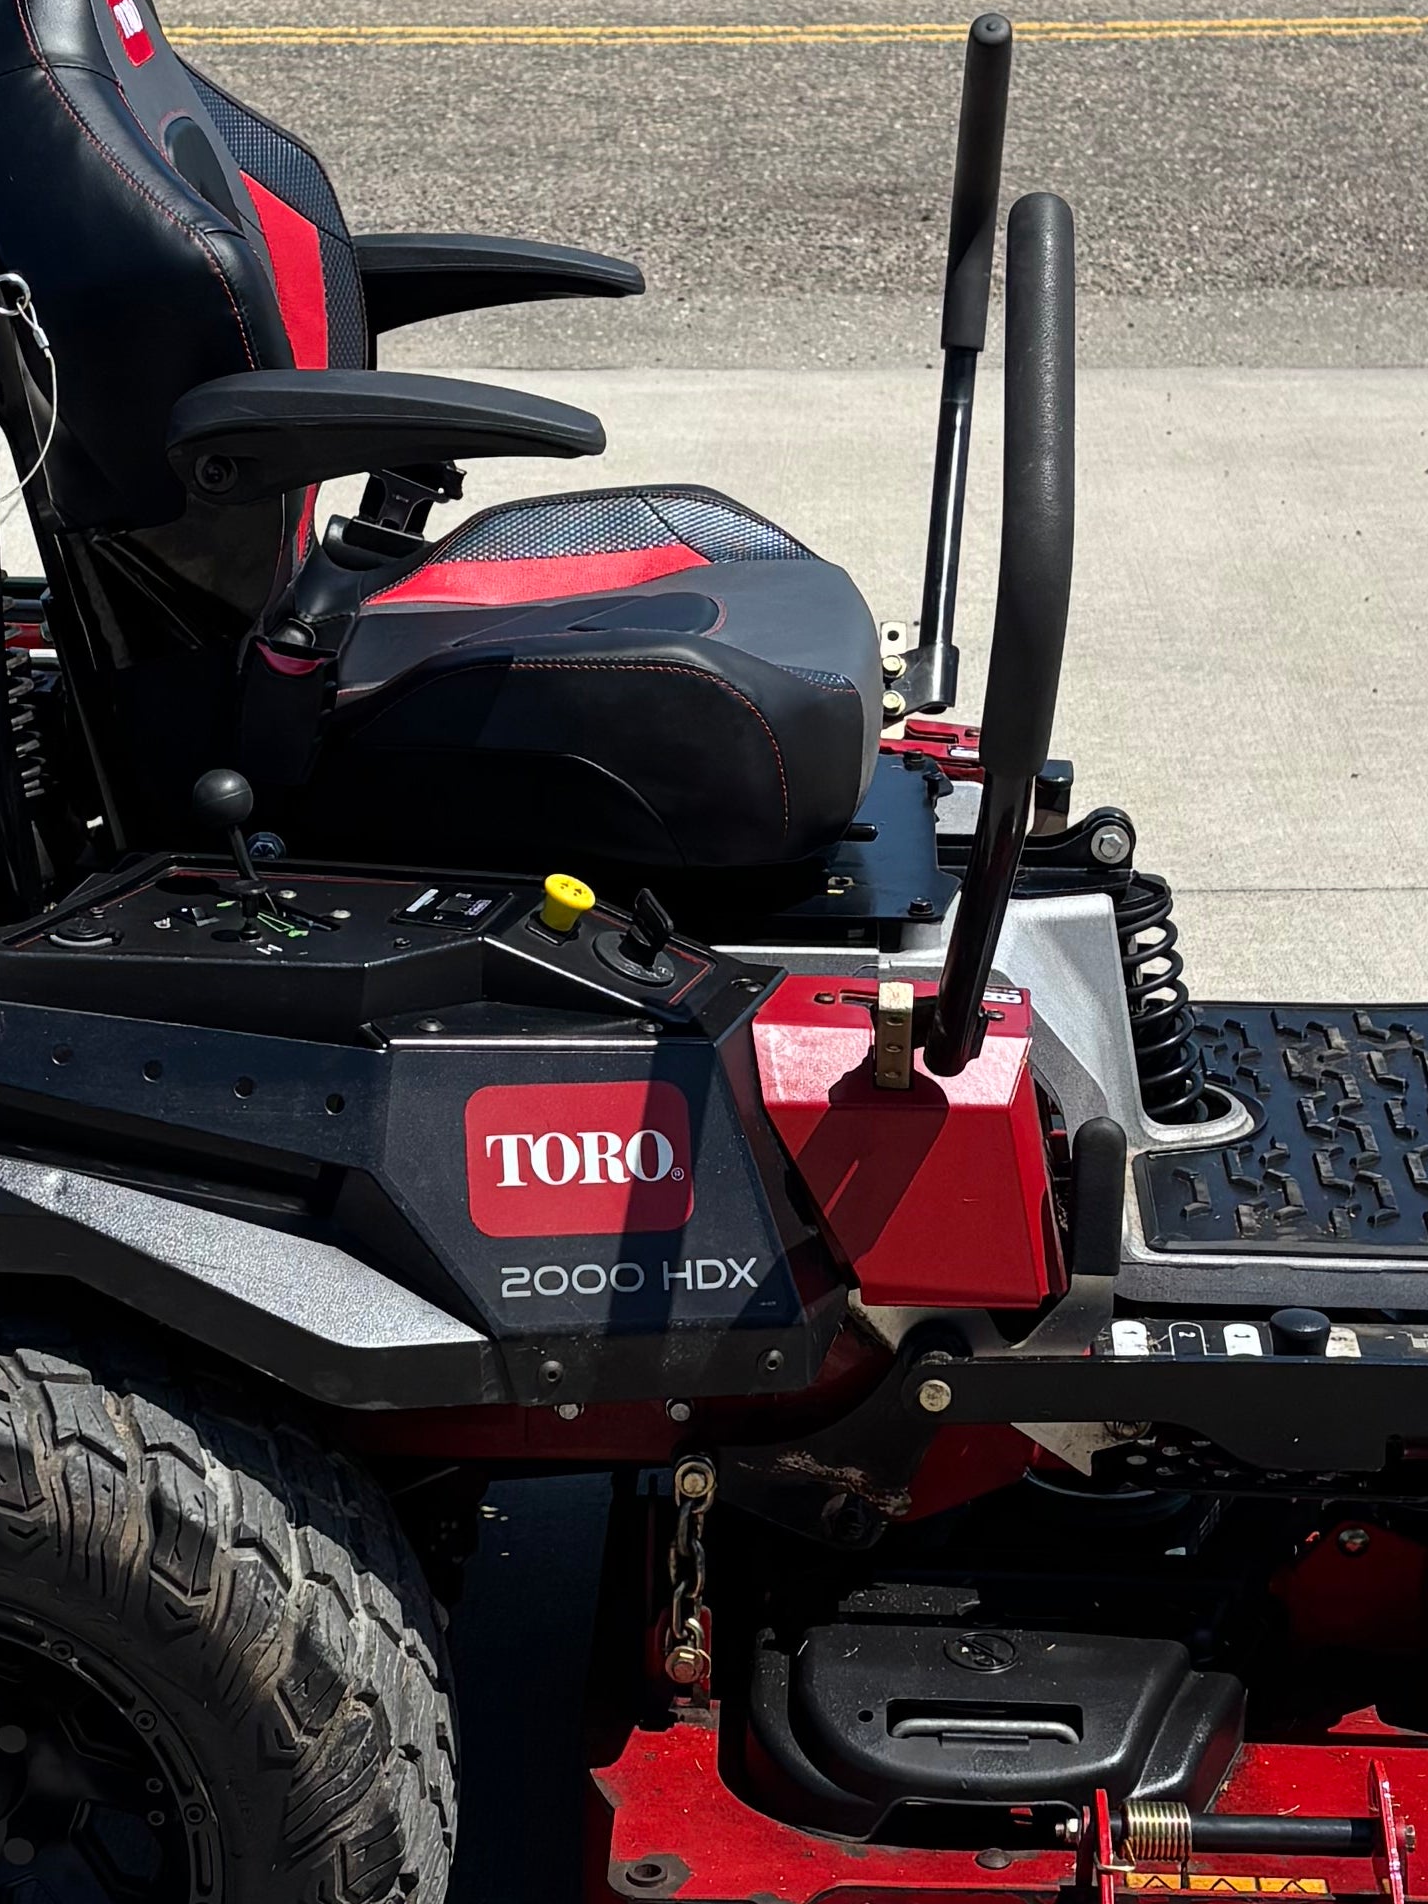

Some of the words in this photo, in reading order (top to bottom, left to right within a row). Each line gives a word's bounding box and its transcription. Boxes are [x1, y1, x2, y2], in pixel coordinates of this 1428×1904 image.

[485, 1129, 674, 1187] TORO
[501, 1262, 645, 1298] 2000
[663, 1257, 758, 1291] HDX
